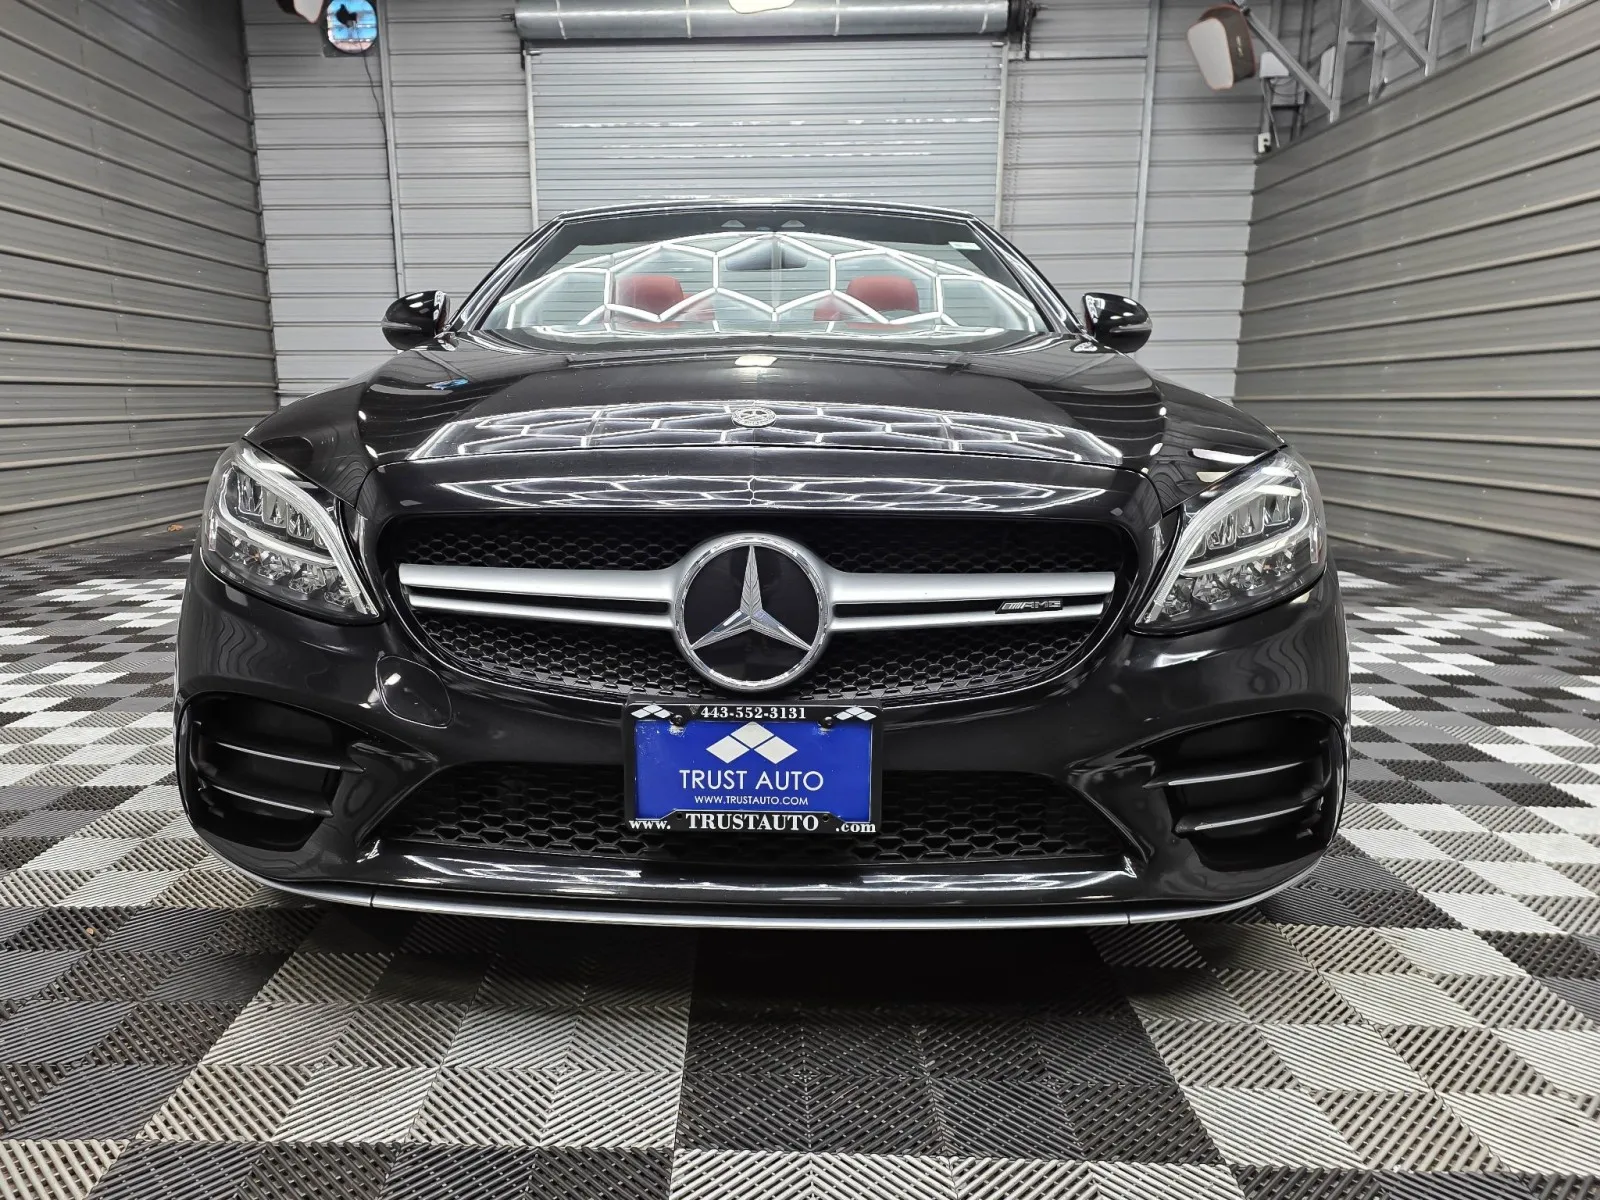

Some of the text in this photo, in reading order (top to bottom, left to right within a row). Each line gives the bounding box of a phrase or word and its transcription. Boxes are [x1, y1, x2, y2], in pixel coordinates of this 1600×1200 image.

[1022, 600, 1061, 609] AMG
[700, 706, 807, 719] 443-552-3131
[679, 769, 824, 791] TRUST AUTO
[694, 795, 809, 806] WWW.TRUSTAUTO.COM
[628, 813, 876, 833] www. TRUSTAUTO .com
